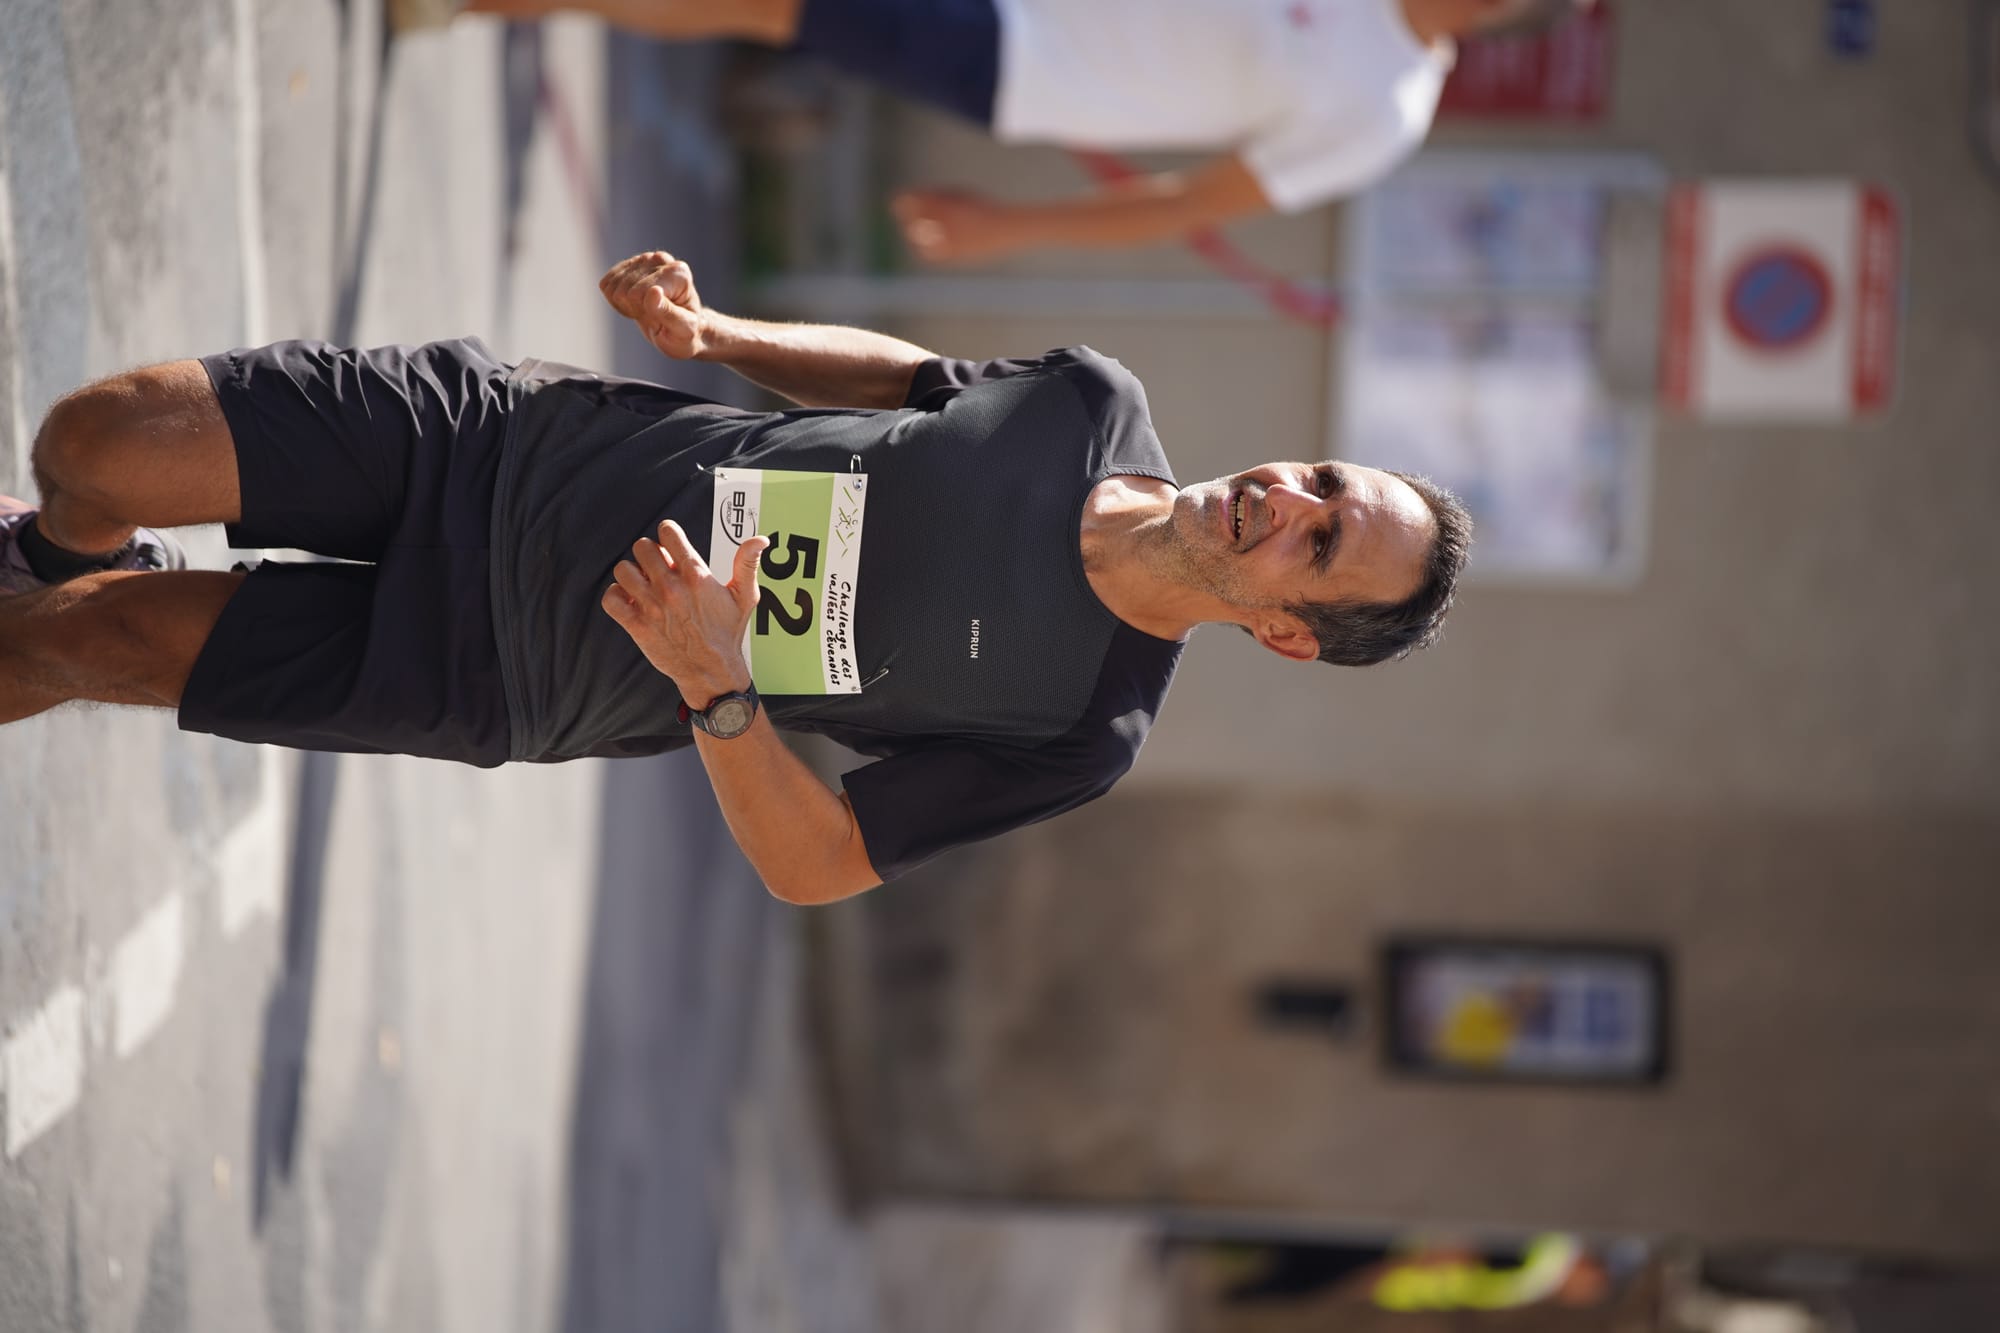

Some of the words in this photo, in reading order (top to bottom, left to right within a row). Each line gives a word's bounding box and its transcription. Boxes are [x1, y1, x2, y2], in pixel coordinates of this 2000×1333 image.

[732, 491, 745, 538] BFP
[756, 531, 819, 637] 52
[826, 573, 840, 621] vallées
[836, 581, 852, 650] Challenge
[969, 619, 980, 659] KIPRUN
[826, 629, 840, 686] cévenoles
[841, 657, 853, 680] des
